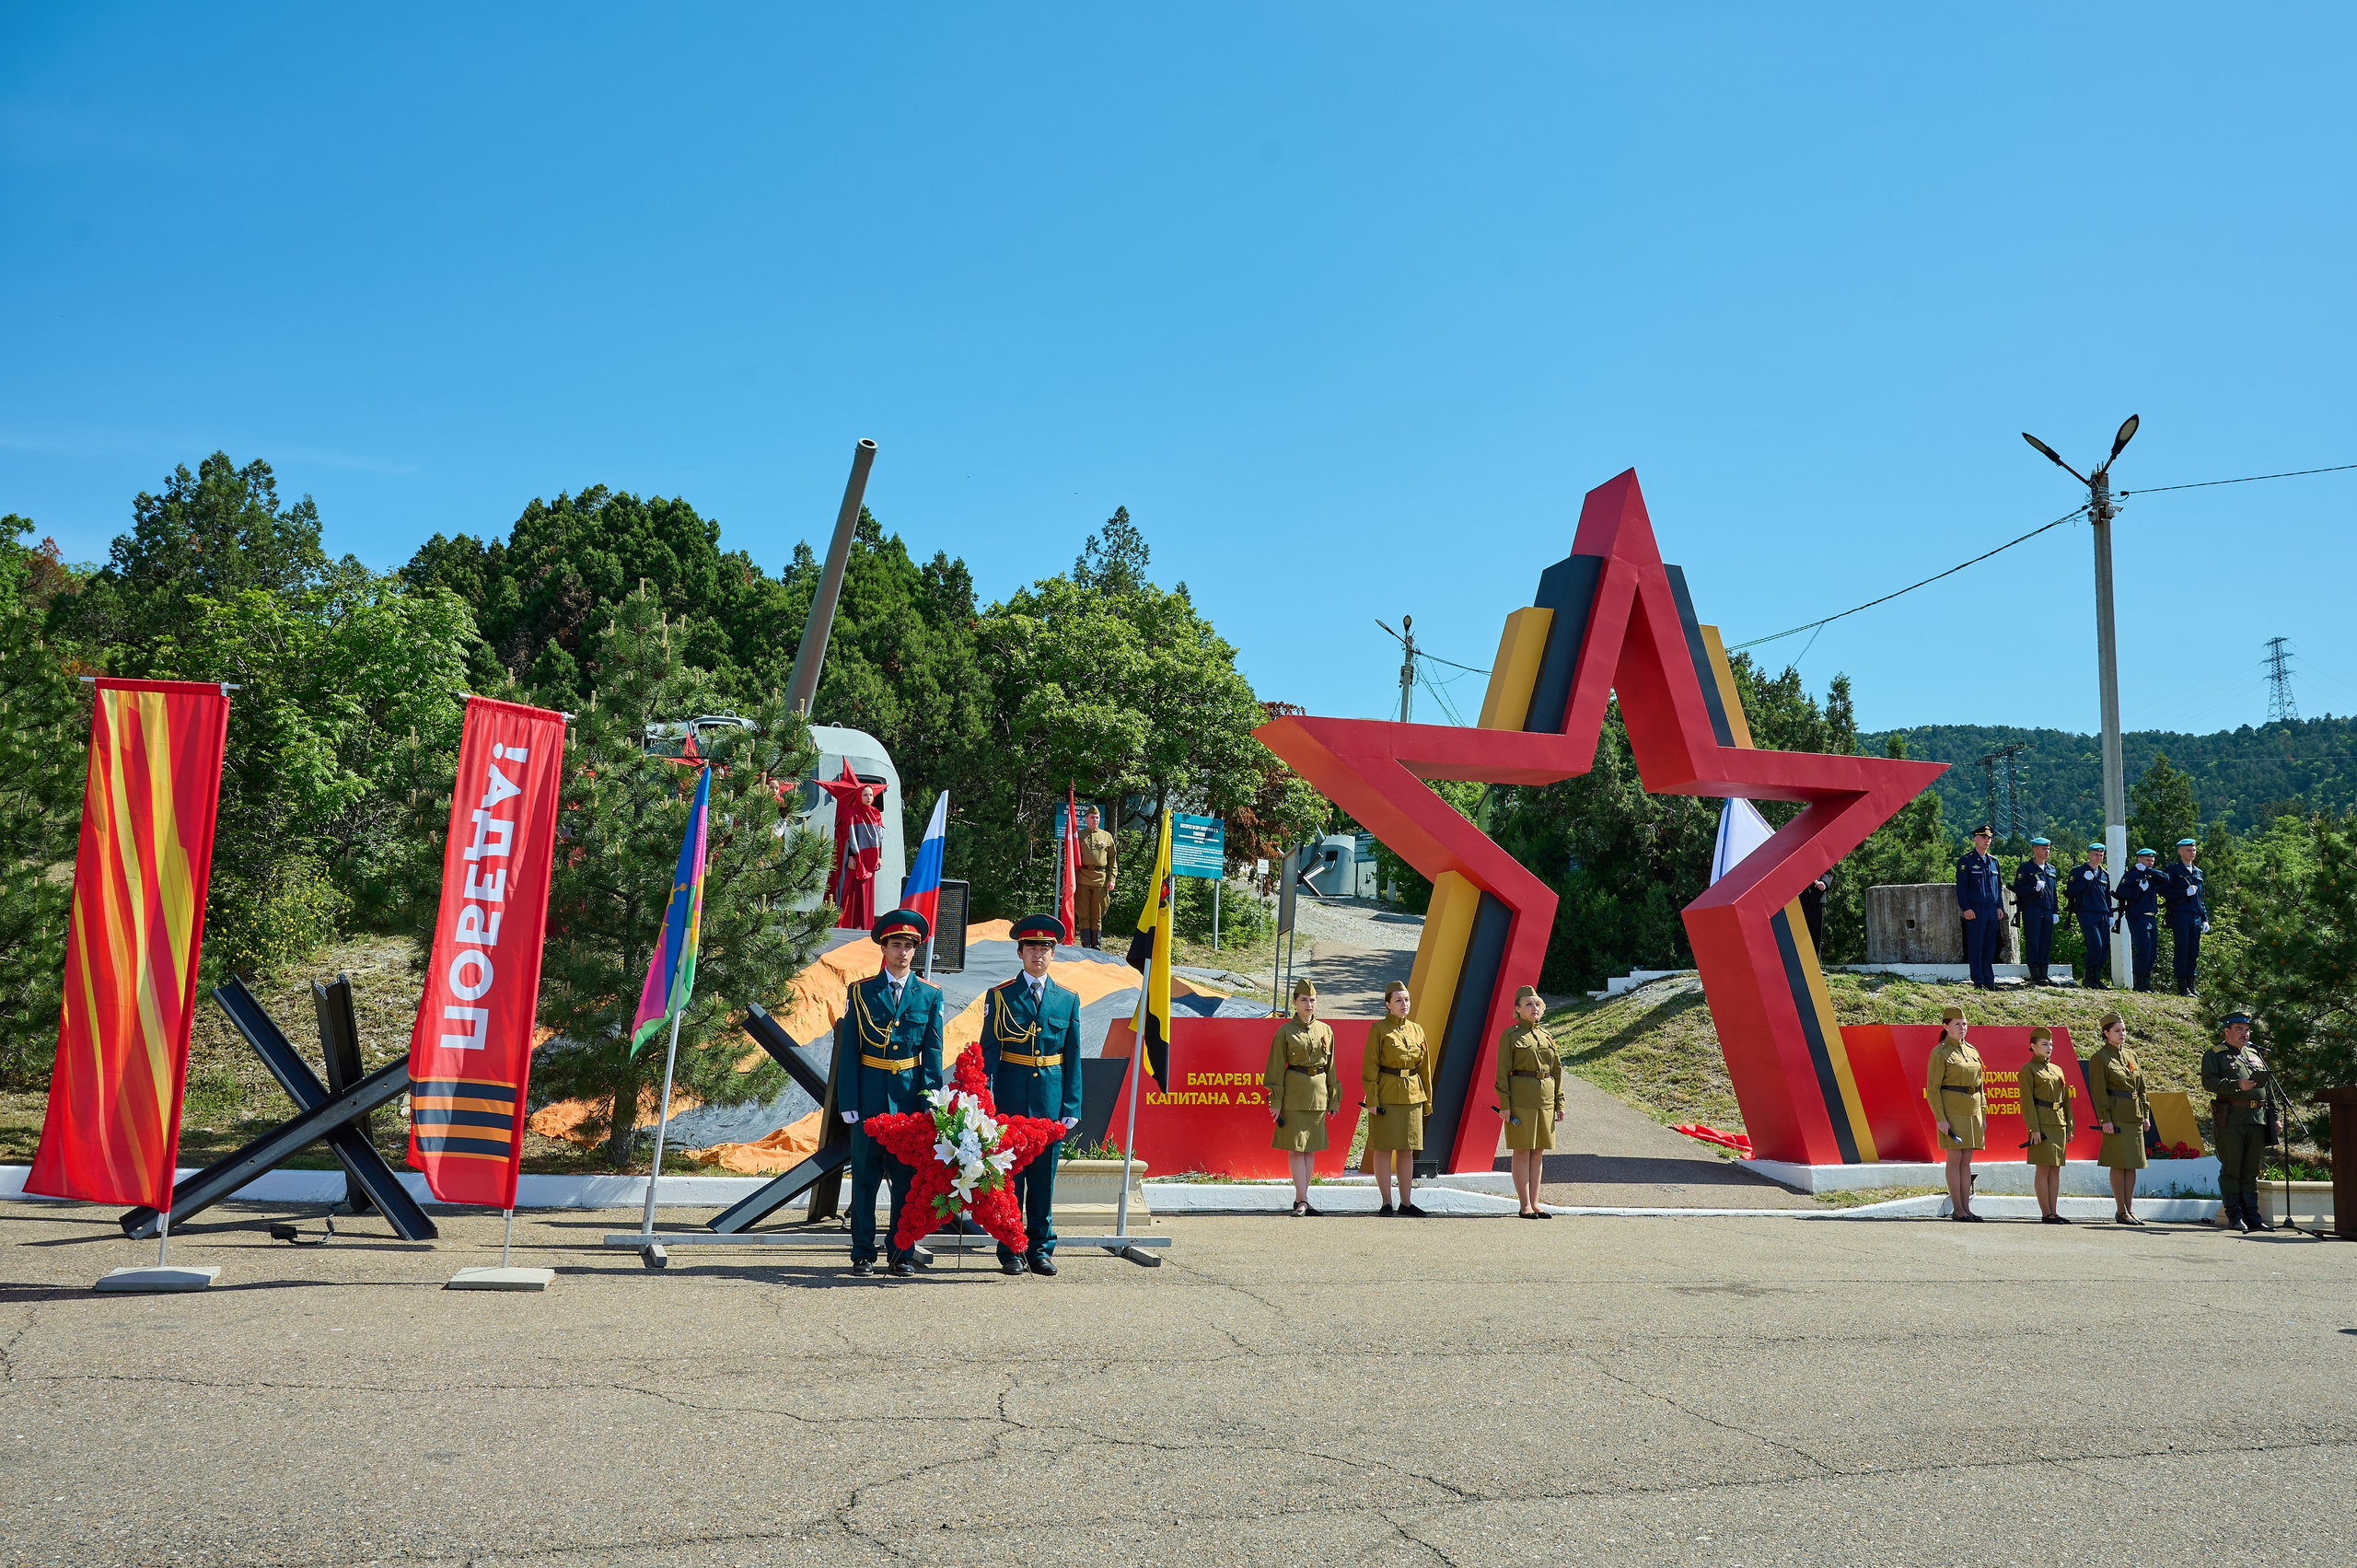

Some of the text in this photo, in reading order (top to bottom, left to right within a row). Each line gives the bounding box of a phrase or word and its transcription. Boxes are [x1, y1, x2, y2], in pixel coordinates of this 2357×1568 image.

[1187, 1073, 1251, 1086] БАТАРЕЯ
[1145, 1092, 1230, 1105] КАПИТАНА
[1985, 1100, 2021, 1115] МУЗЕЙ
